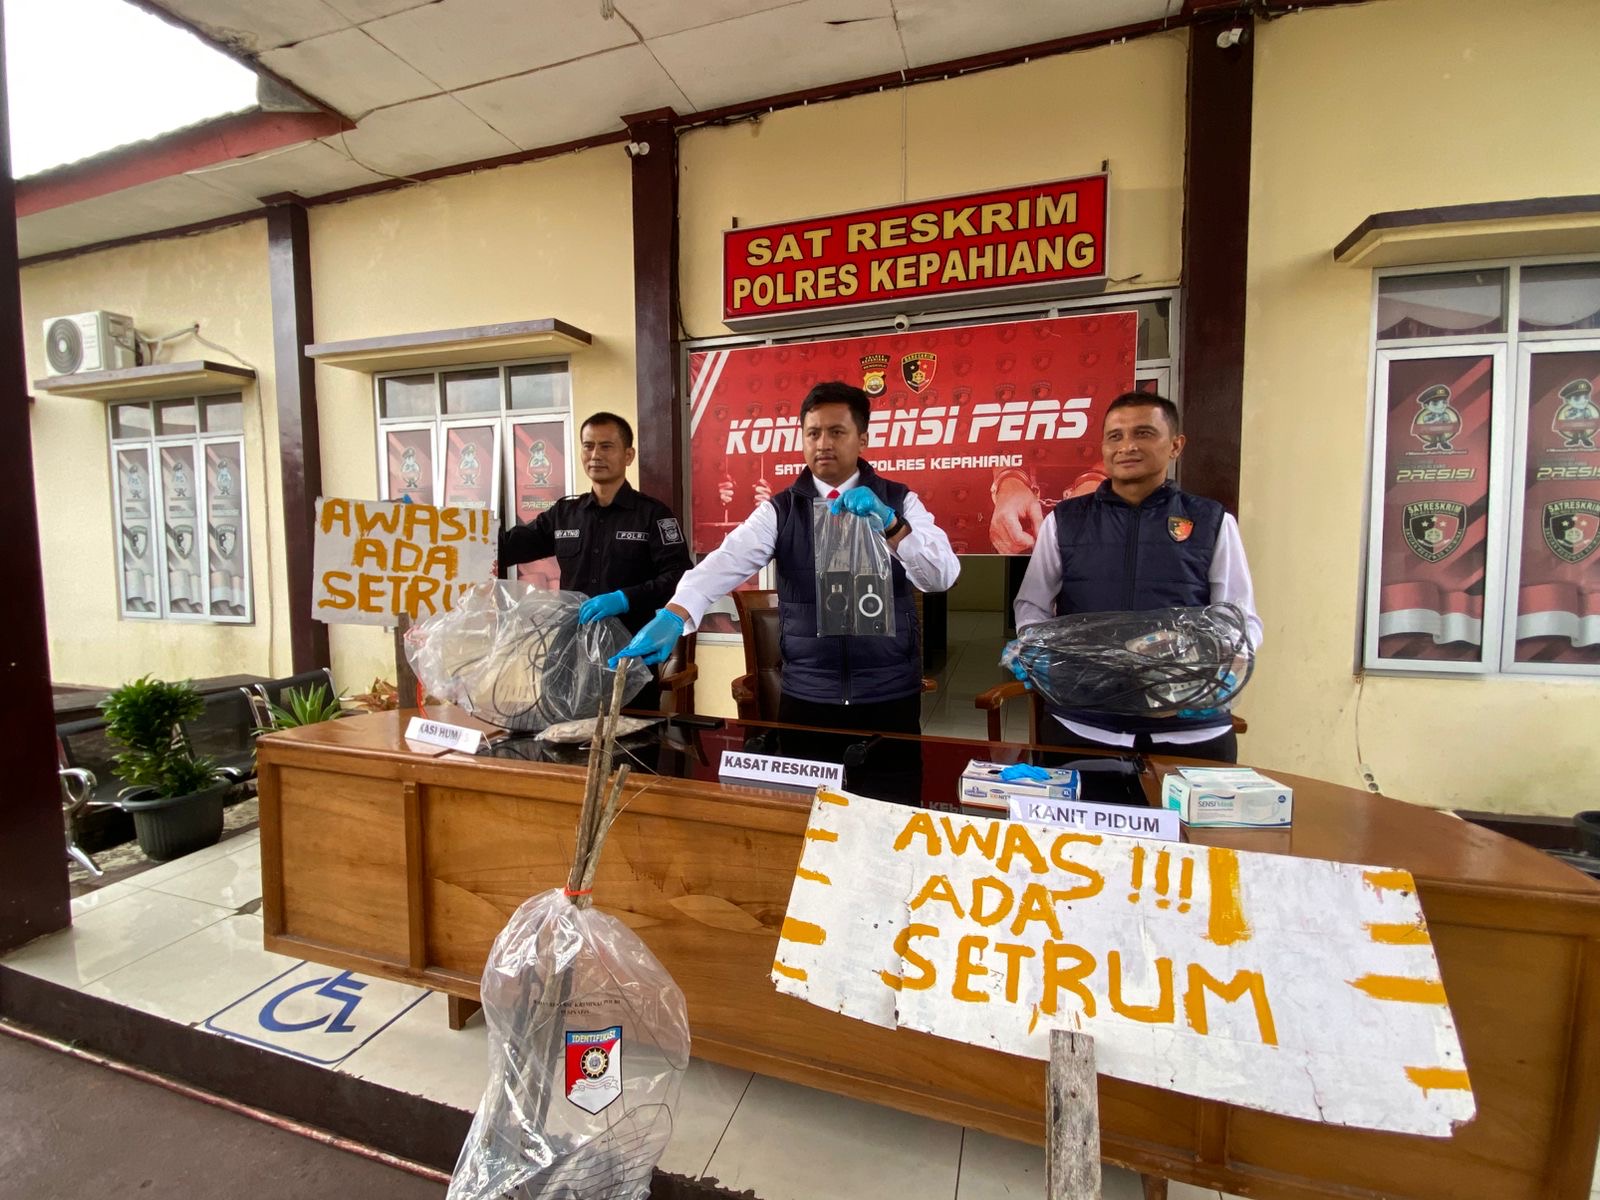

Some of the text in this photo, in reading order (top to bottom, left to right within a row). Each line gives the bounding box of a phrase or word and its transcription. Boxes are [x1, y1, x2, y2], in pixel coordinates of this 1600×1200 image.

[746, 192, 1077, 267] SAT RESKRIM
[733, 232, 1095, 309] POLRES KEPAHIANG
[725, 397, 1093, 456] KONENSI PERS
[869, 454, 1023, 473] POLRES KEPAHIANG
[1396, 468, 1476, 480] PRESISI
[320, 498, 490, 545] AWAS!!
[1407, 502, 1463, 514] SATRESKRIM
[351, 538, 459, 581] ADA
[724, 755, 839, 780] KASAT RESKRIM
[1028, 803, 1160, 834] KANIT PIDUM
[1198, 800, 1217, 808] SENSI
[907, 873, 1064, 940] ADA
[880, 923, 1279, 1046] SETRUM
[571, 1029, 617, 1043] IDENTIFIKASI
